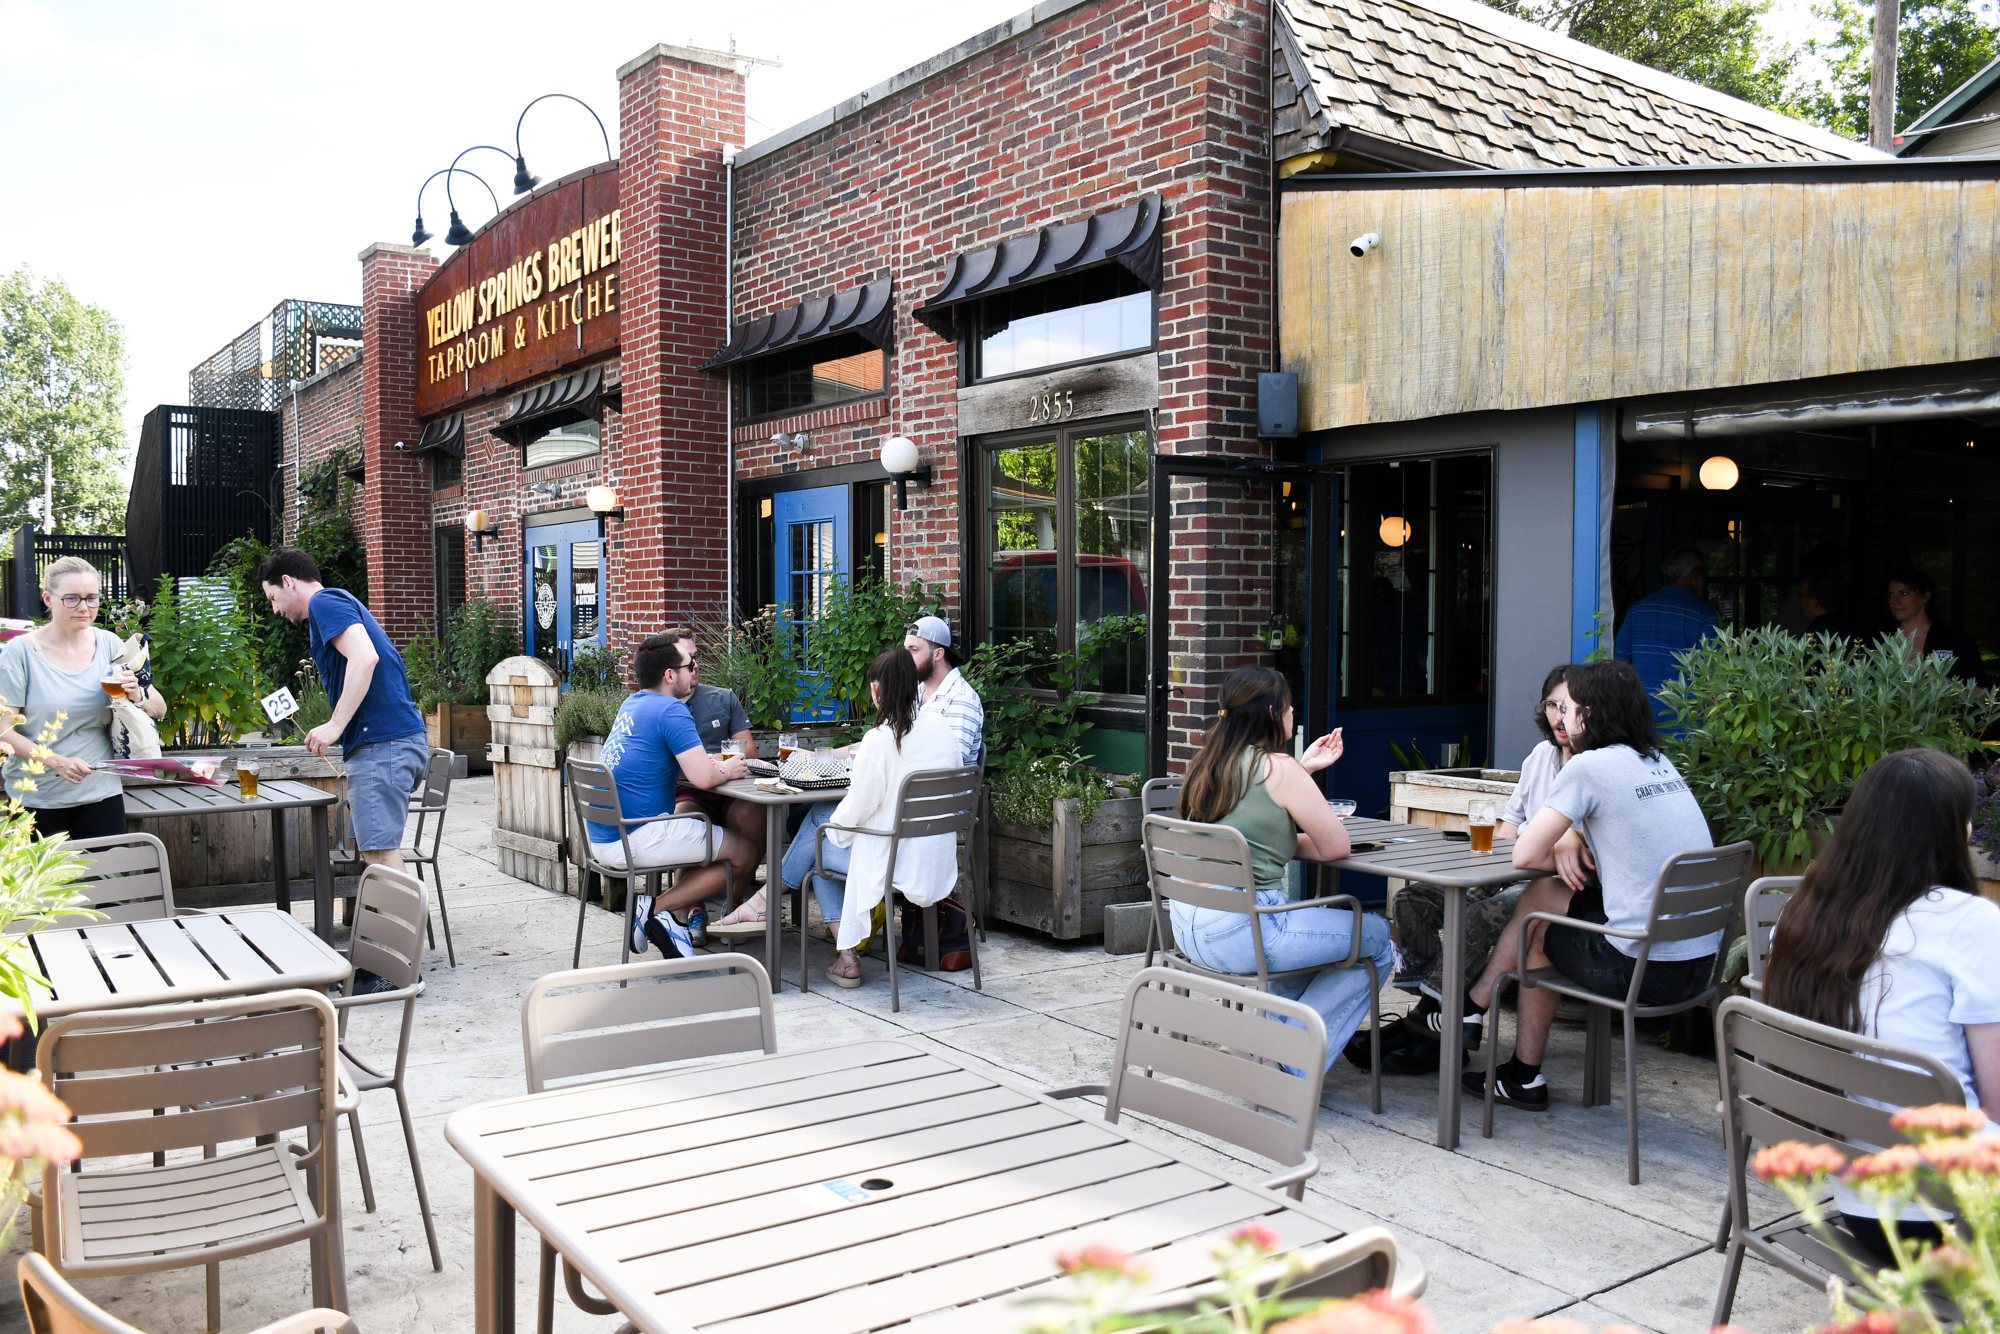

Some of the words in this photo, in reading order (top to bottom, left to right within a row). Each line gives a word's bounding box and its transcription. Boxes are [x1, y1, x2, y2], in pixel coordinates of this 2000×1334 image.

[426, 286, 475, 348] YELLOW
[478, 251, 544, 325] SPRINGS
[428, 325, 503, 384] TAPROOM
[514, 316, 526, 349] &
[1030, 390, 1073, 421] 2855
[268, 693, 291, 717] 25
[1635, 784, 1665, 799] CRAFTING
